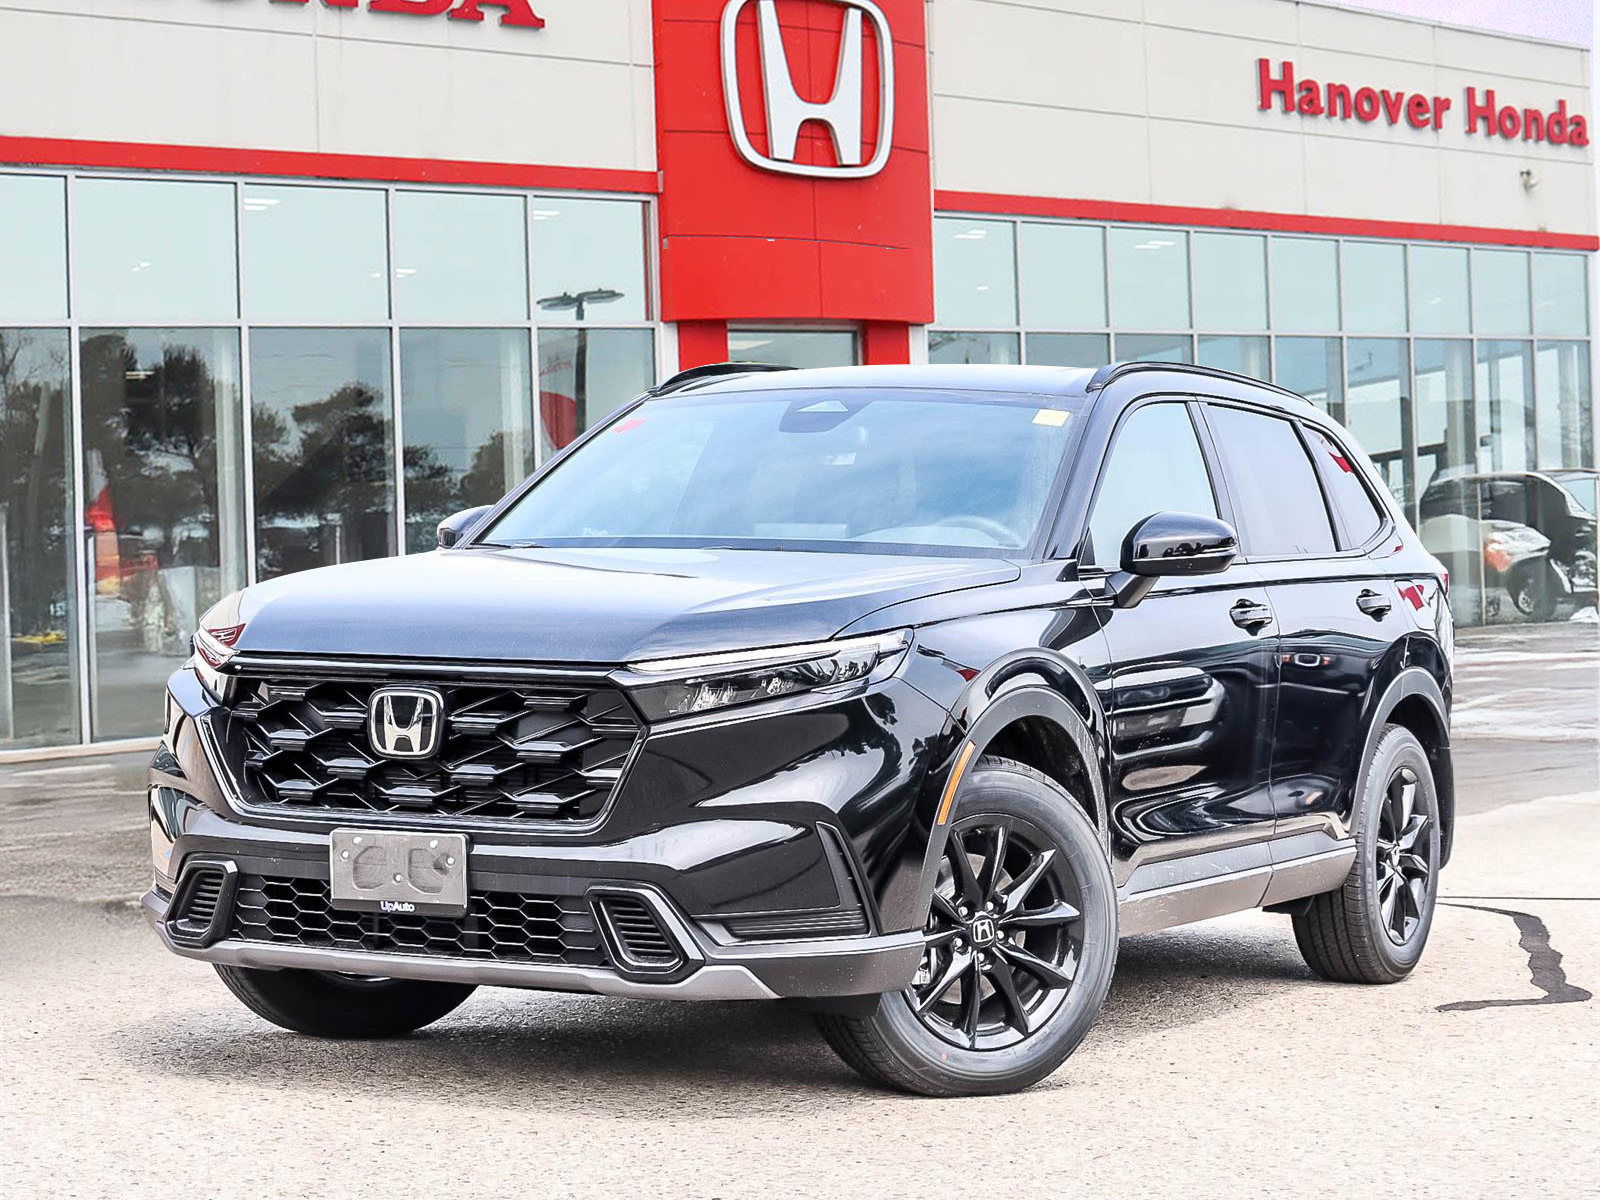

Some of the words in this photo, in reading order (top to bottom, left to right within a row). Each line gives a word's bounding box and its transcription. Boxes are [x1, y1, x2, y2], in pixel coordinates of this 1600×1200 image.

[1257, 57, 1452, 129] Hanover
[1465, 86, 1590, 146] Honda
[380, 900, 415, 913] UpAuto
